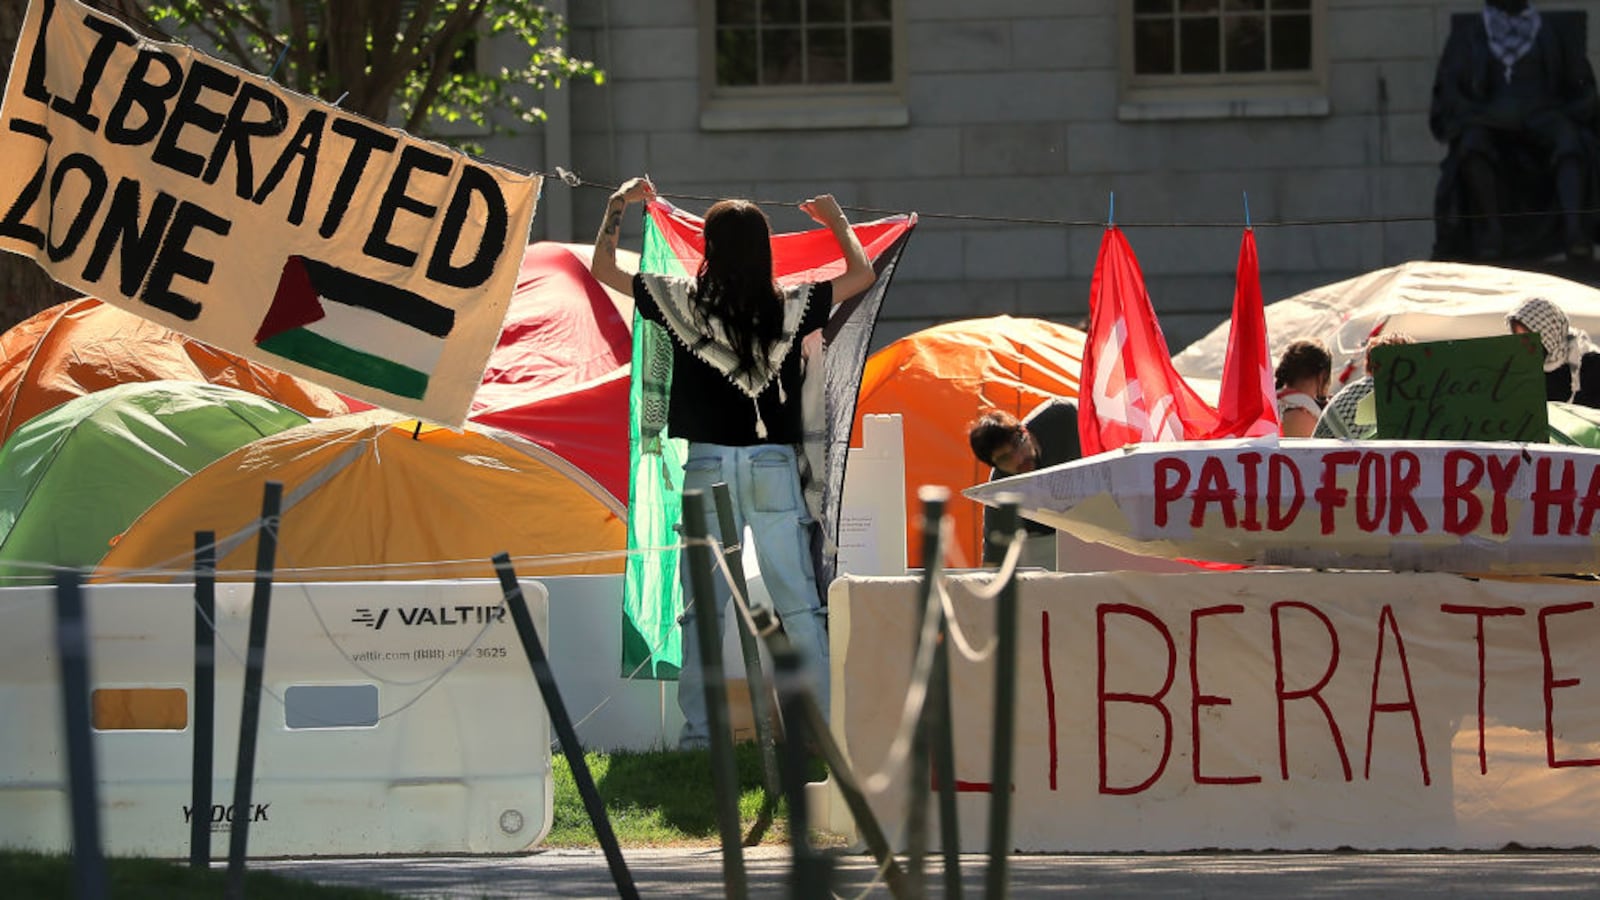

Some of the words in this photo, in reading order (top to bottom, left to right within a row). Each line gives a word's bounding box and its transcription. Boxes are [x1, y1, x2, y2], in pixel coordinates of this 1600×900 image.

[23, 0, 508, 289] LIBERATED
[0, 118, 232, 321] ZONE
[1154, 452, 1305, 532] PAID
[1314, 450, 1429, 535] FOR
[1443, 450, 1521, 536] BY
[398, 606, 507, 625] VALTIR
